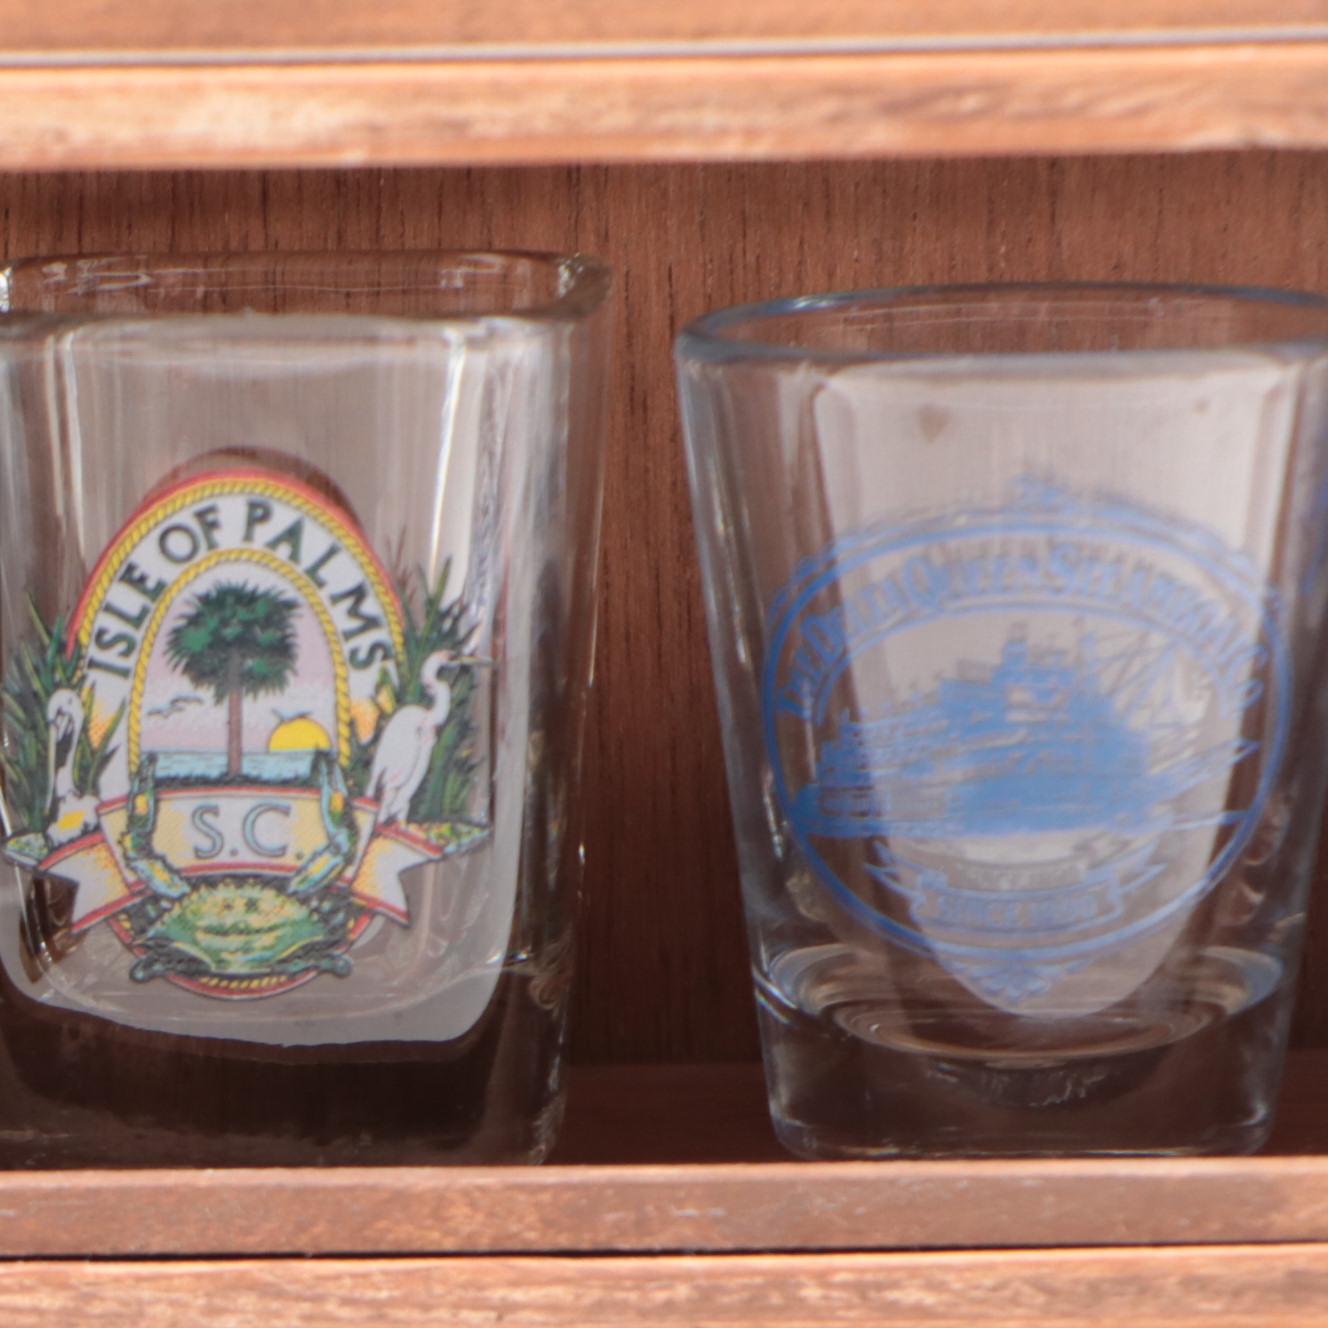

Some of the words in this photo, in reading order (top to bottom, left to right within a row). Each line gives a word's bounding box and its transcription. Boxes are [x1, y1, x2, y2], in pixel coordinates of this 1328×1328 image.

[88, 563, 167, 678] ISLE
[158, 503, 220, 563] OF
[244, 500, 394, 671] PALMS
[190, 802, 304, 860] S.C.
